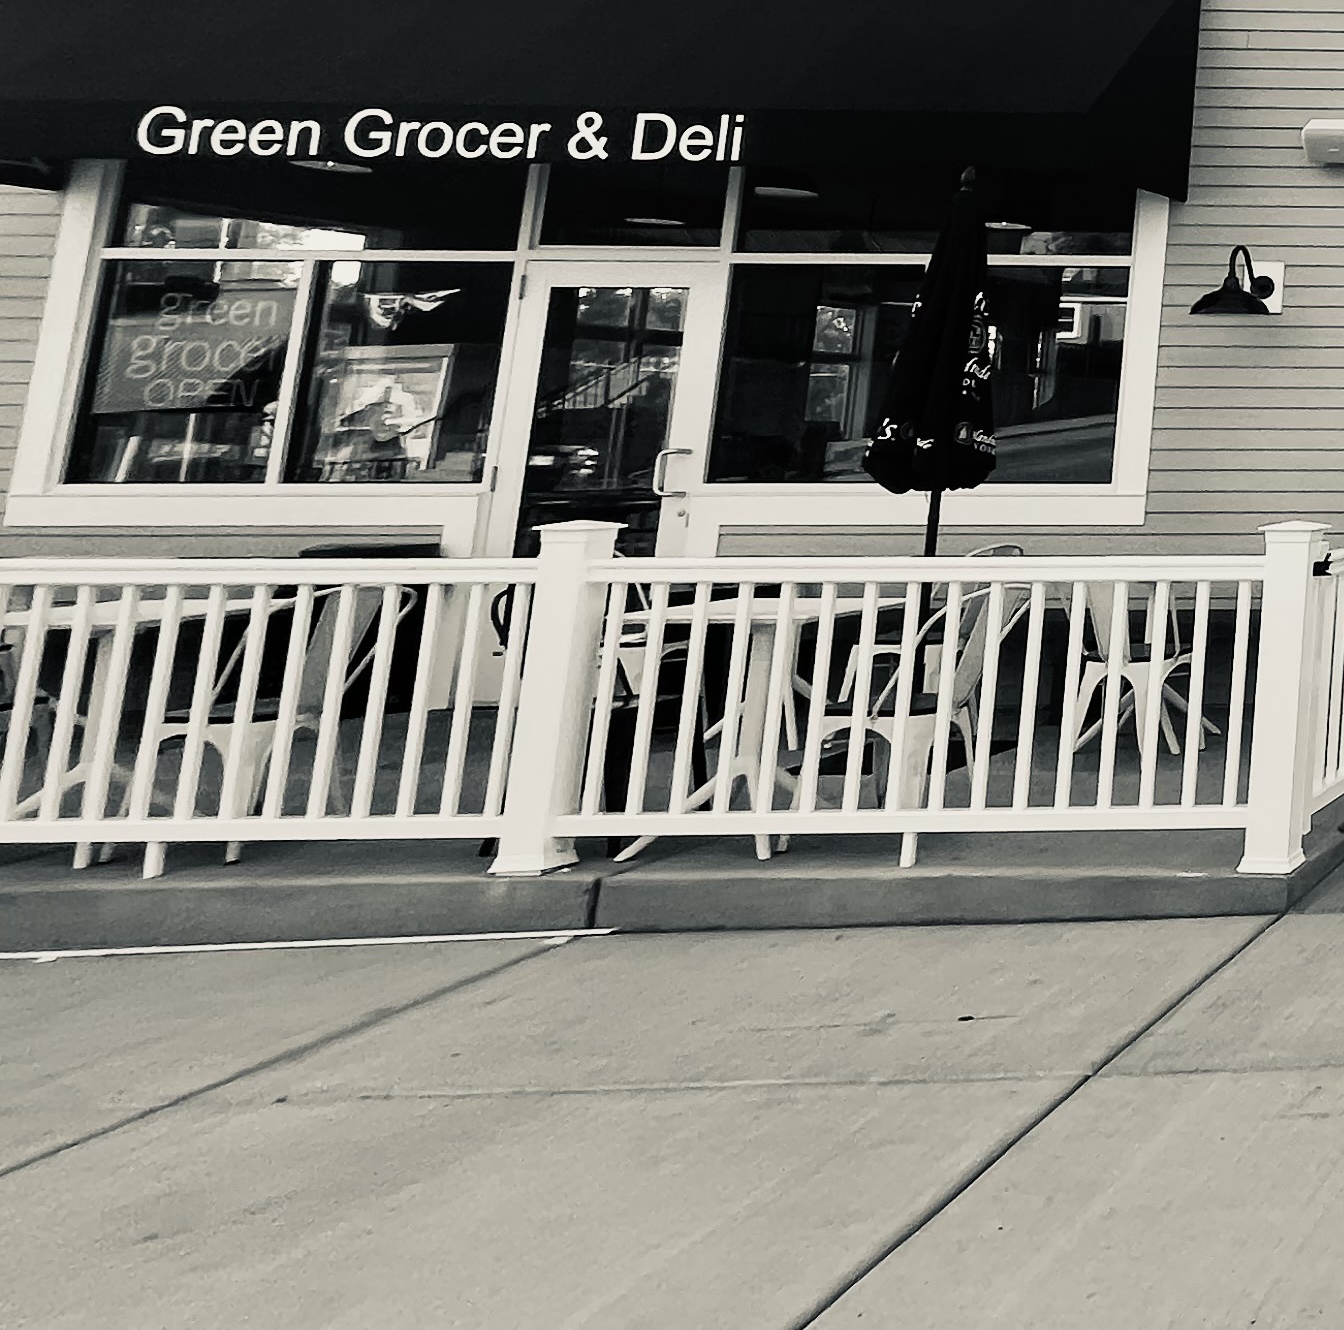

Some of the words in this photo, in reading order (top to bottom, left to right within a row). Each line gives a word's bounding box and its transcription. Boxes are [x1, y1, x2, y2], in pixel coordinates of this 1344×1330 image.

[136, 105, 321, 156] Green
[343, 108, 552, 159] Grocer
[567, 111, 609, 160] &
[630, 112, 746, 162] Deli
[155, 293, 278, 330] green
[144, 378, 259, 406] OPEN
